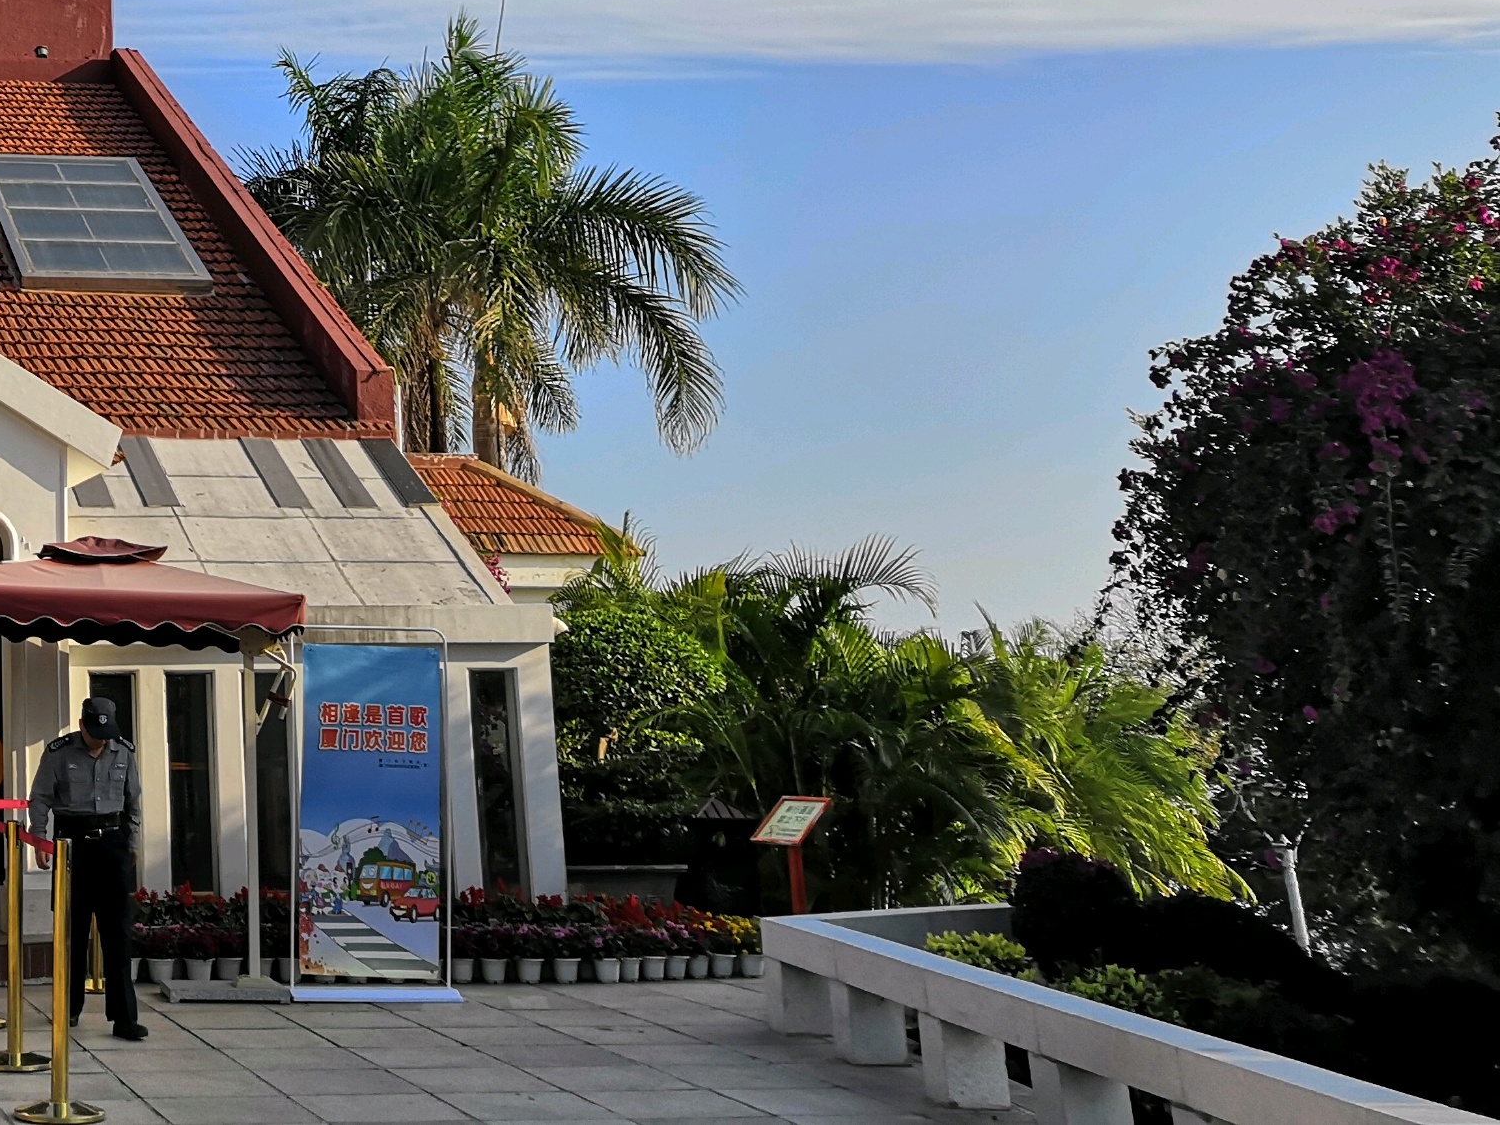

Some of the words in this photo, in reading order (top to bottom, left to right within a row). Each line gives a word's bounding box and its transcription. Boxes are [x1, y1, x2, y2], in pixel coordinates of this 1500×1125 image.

[320, 702, 428, 728] 相逢是首歌
[319, 727, 428, 753] 厦门欢迎您
